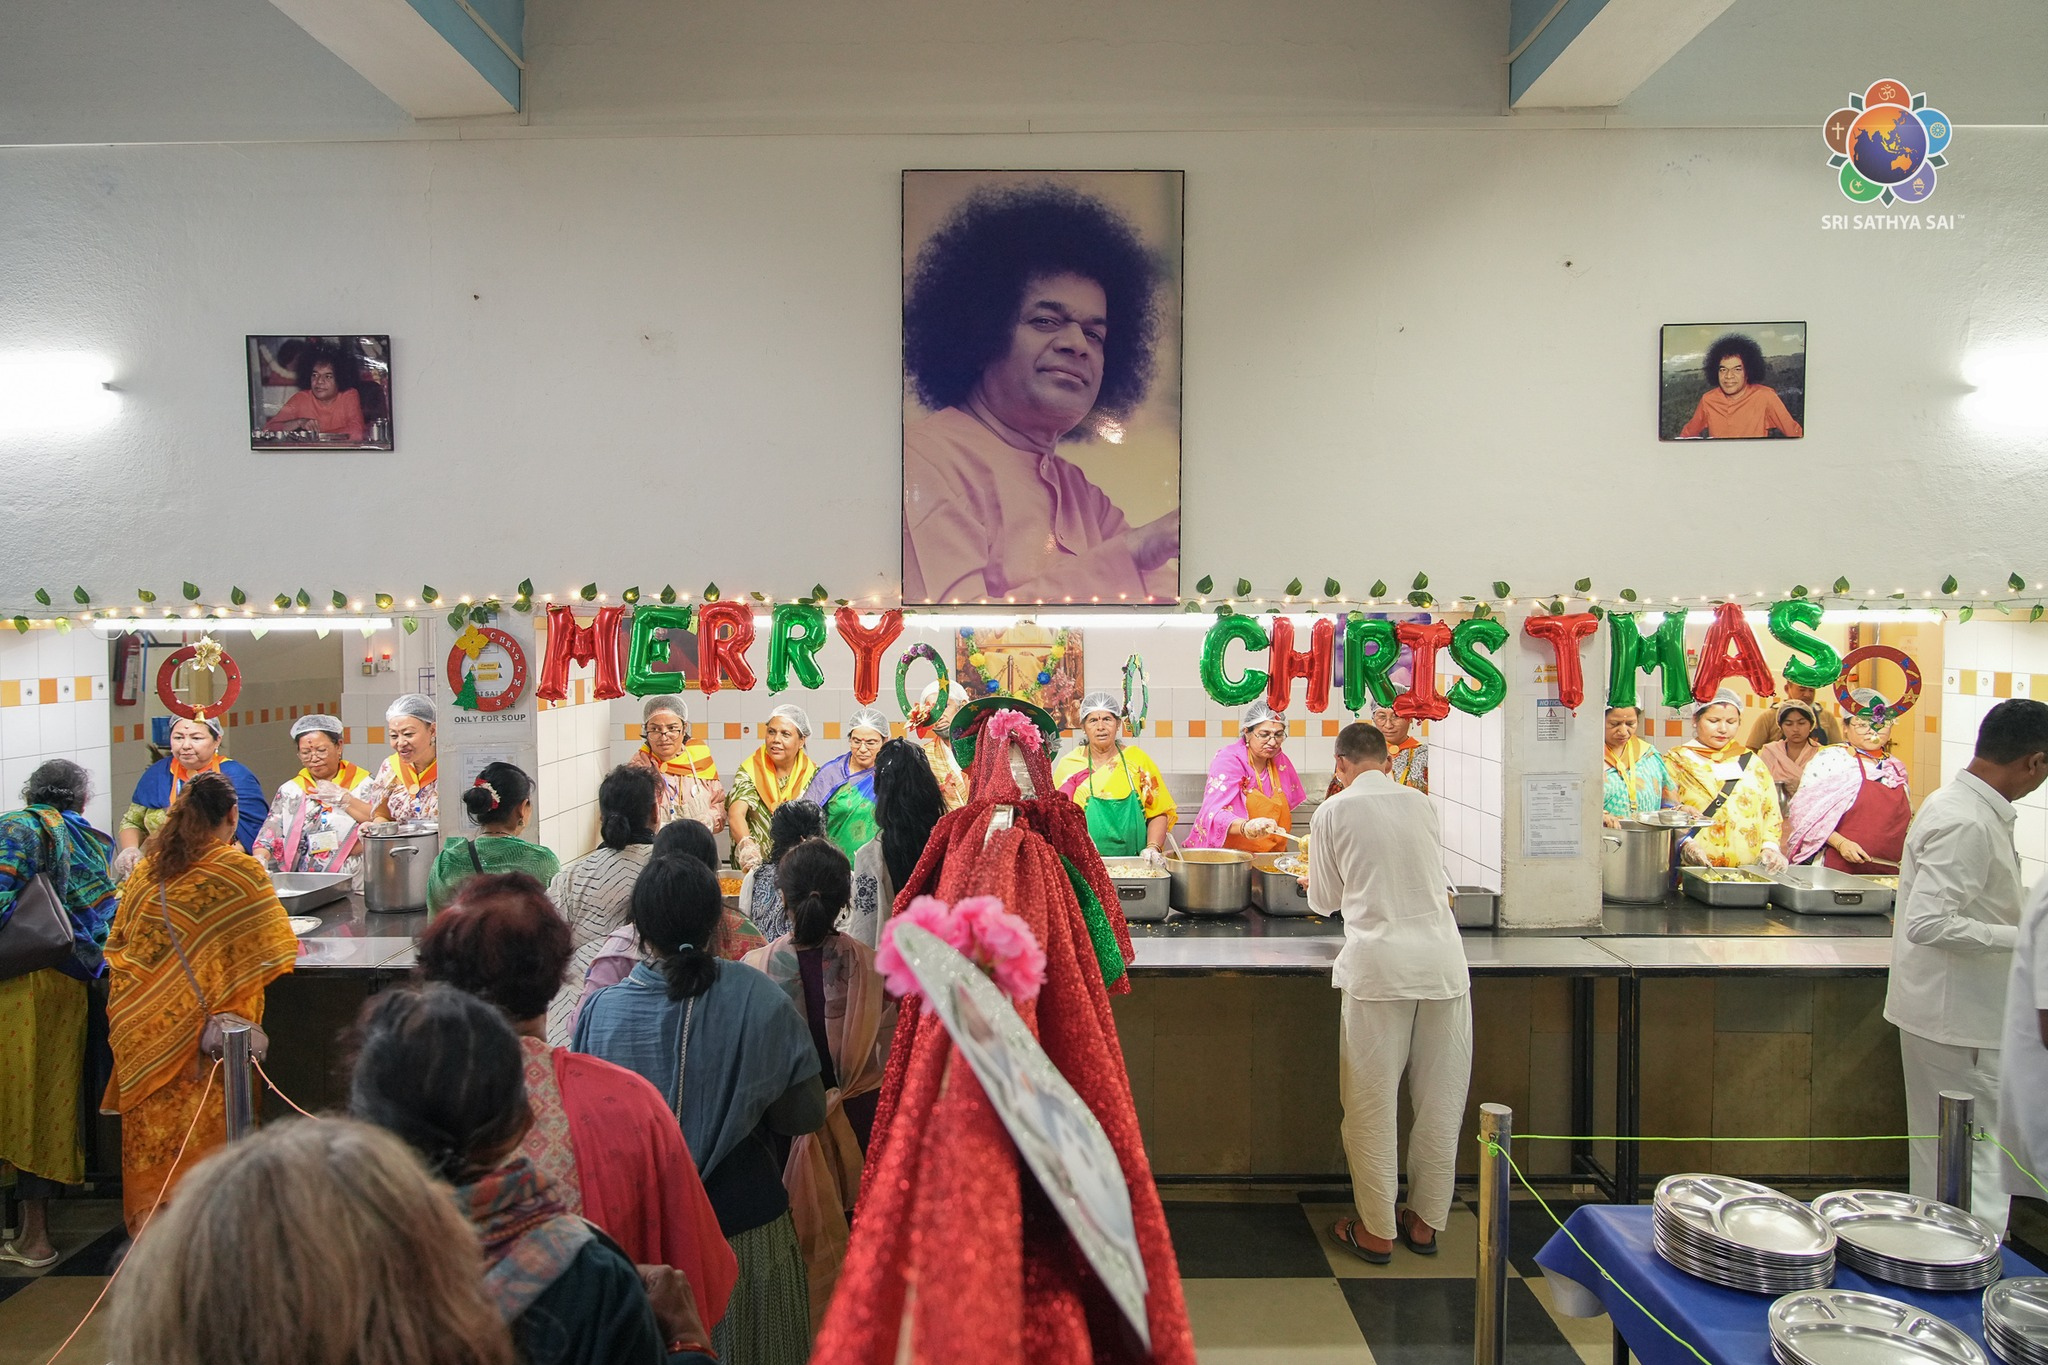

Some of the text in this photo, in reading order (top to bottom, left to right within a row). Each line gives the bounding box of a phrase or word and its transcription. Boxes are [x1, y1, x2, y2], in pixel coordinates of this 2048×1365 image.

[489, 631, 523, 706] CHRISTMAS
[536, 600, 1843, 724] MERRY CHRISTMAS
